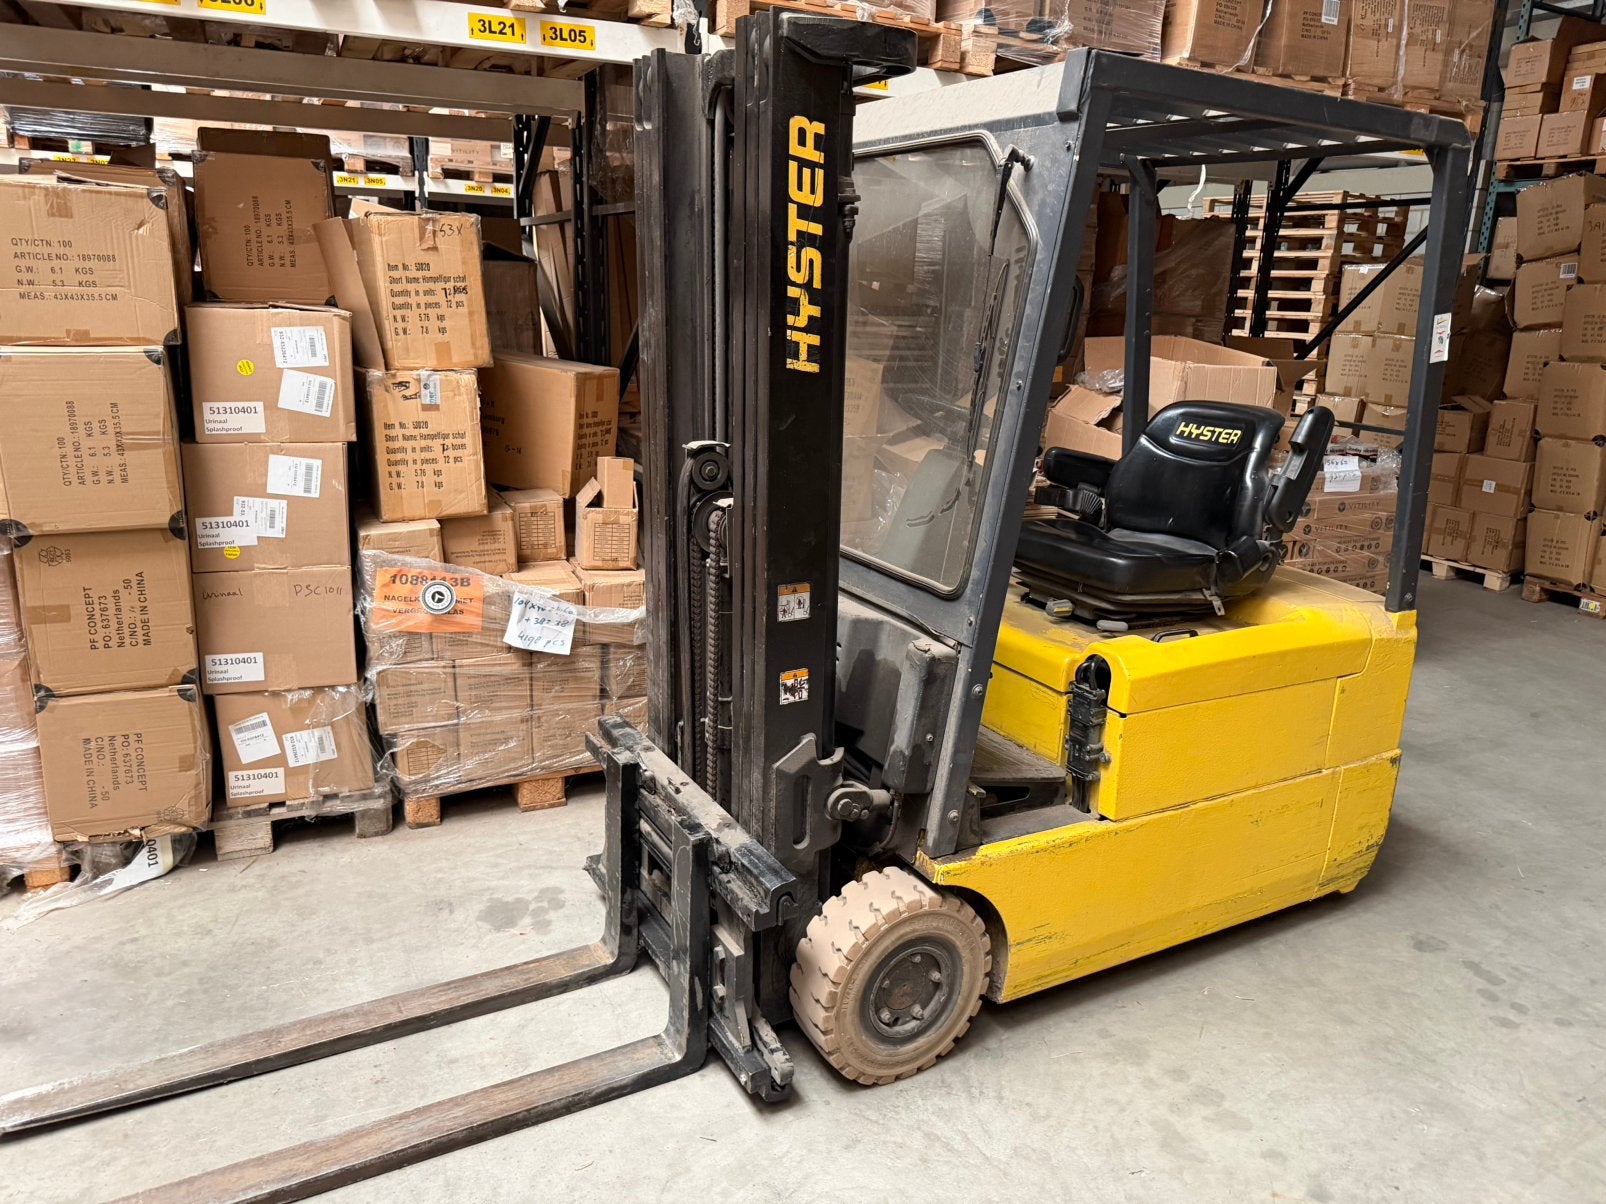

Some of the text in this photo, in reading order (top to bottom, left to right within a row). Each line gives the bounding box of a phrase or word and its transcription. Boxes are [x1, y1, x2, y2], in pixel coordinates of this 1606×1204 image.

[478, 18, 516, 36] 3L21
[550, 26, 586, 44] 3L05
[11, 238, 72, 248] QTY/CTN: 100
[786, 116, 826, 373] HYSTER
[14, 252, 54, 261] ARTICLE
[77, 254, 117, 262] 18970088
[16, 265, 94, 275] G.W.: 6.1 KGS
[389, 276, 402, 284] Short
[390, 288, 412, 298] Quantity
[415, 288, 420, 296] in
[423, 288, 438, 296] units:
[392, 302, 412, 310] Quantity
[416, 302, 422, 310] in
[456, 300, 464, 308] pcs
[436, 314, 446, 322] kgs
[438, 326, 448, 334] kgs
[110, 402, 120, 414] CM
[210, 406, 258, 414] 51310401
[66, 400, 78, 434] 18970088
[84, 421, 94, 437] KGS
[98, 419, 108, 435] KGS
[385, 434, 399, 442] Short
[1176, 422, 1241, 444] HYSTER
[88, 446, 96, 457] 6.1
[102, 446, 111, 456] 5.3
[386, 446, 408, 455] Quantity
[420, 446, 435, 454] units:
[57, 437, 72, 486] QTY/CTN: 100
[387, 456, 463, 467] Quantity in pieces: 72 pcs
[74, 454, 86, 486] ARTICLE
[434, 469, 442, 478] kgs
[434, 480, 444, 489] kgs
[202, 520, 250, 530] 51310401
[98, 595, 110, 629] 637673
[136, 572, 152, 646] MADE IN CHINA
[83, 586, 98, 650] PF CONCEPT
[112, 589, 126, 648] Netherlands
[212, 656, 258, 666] 51310401
[108, 736, 121, 790] Netherlands
[122, 752, 134, 784] 637673
[134, 733, 148, 792] PF CONCEPT
[82, 738, 98, 808] MADE IN CHINA
[234, 772, 278, 782] 51310401
[230, 790, 264, 798] Splashproof
